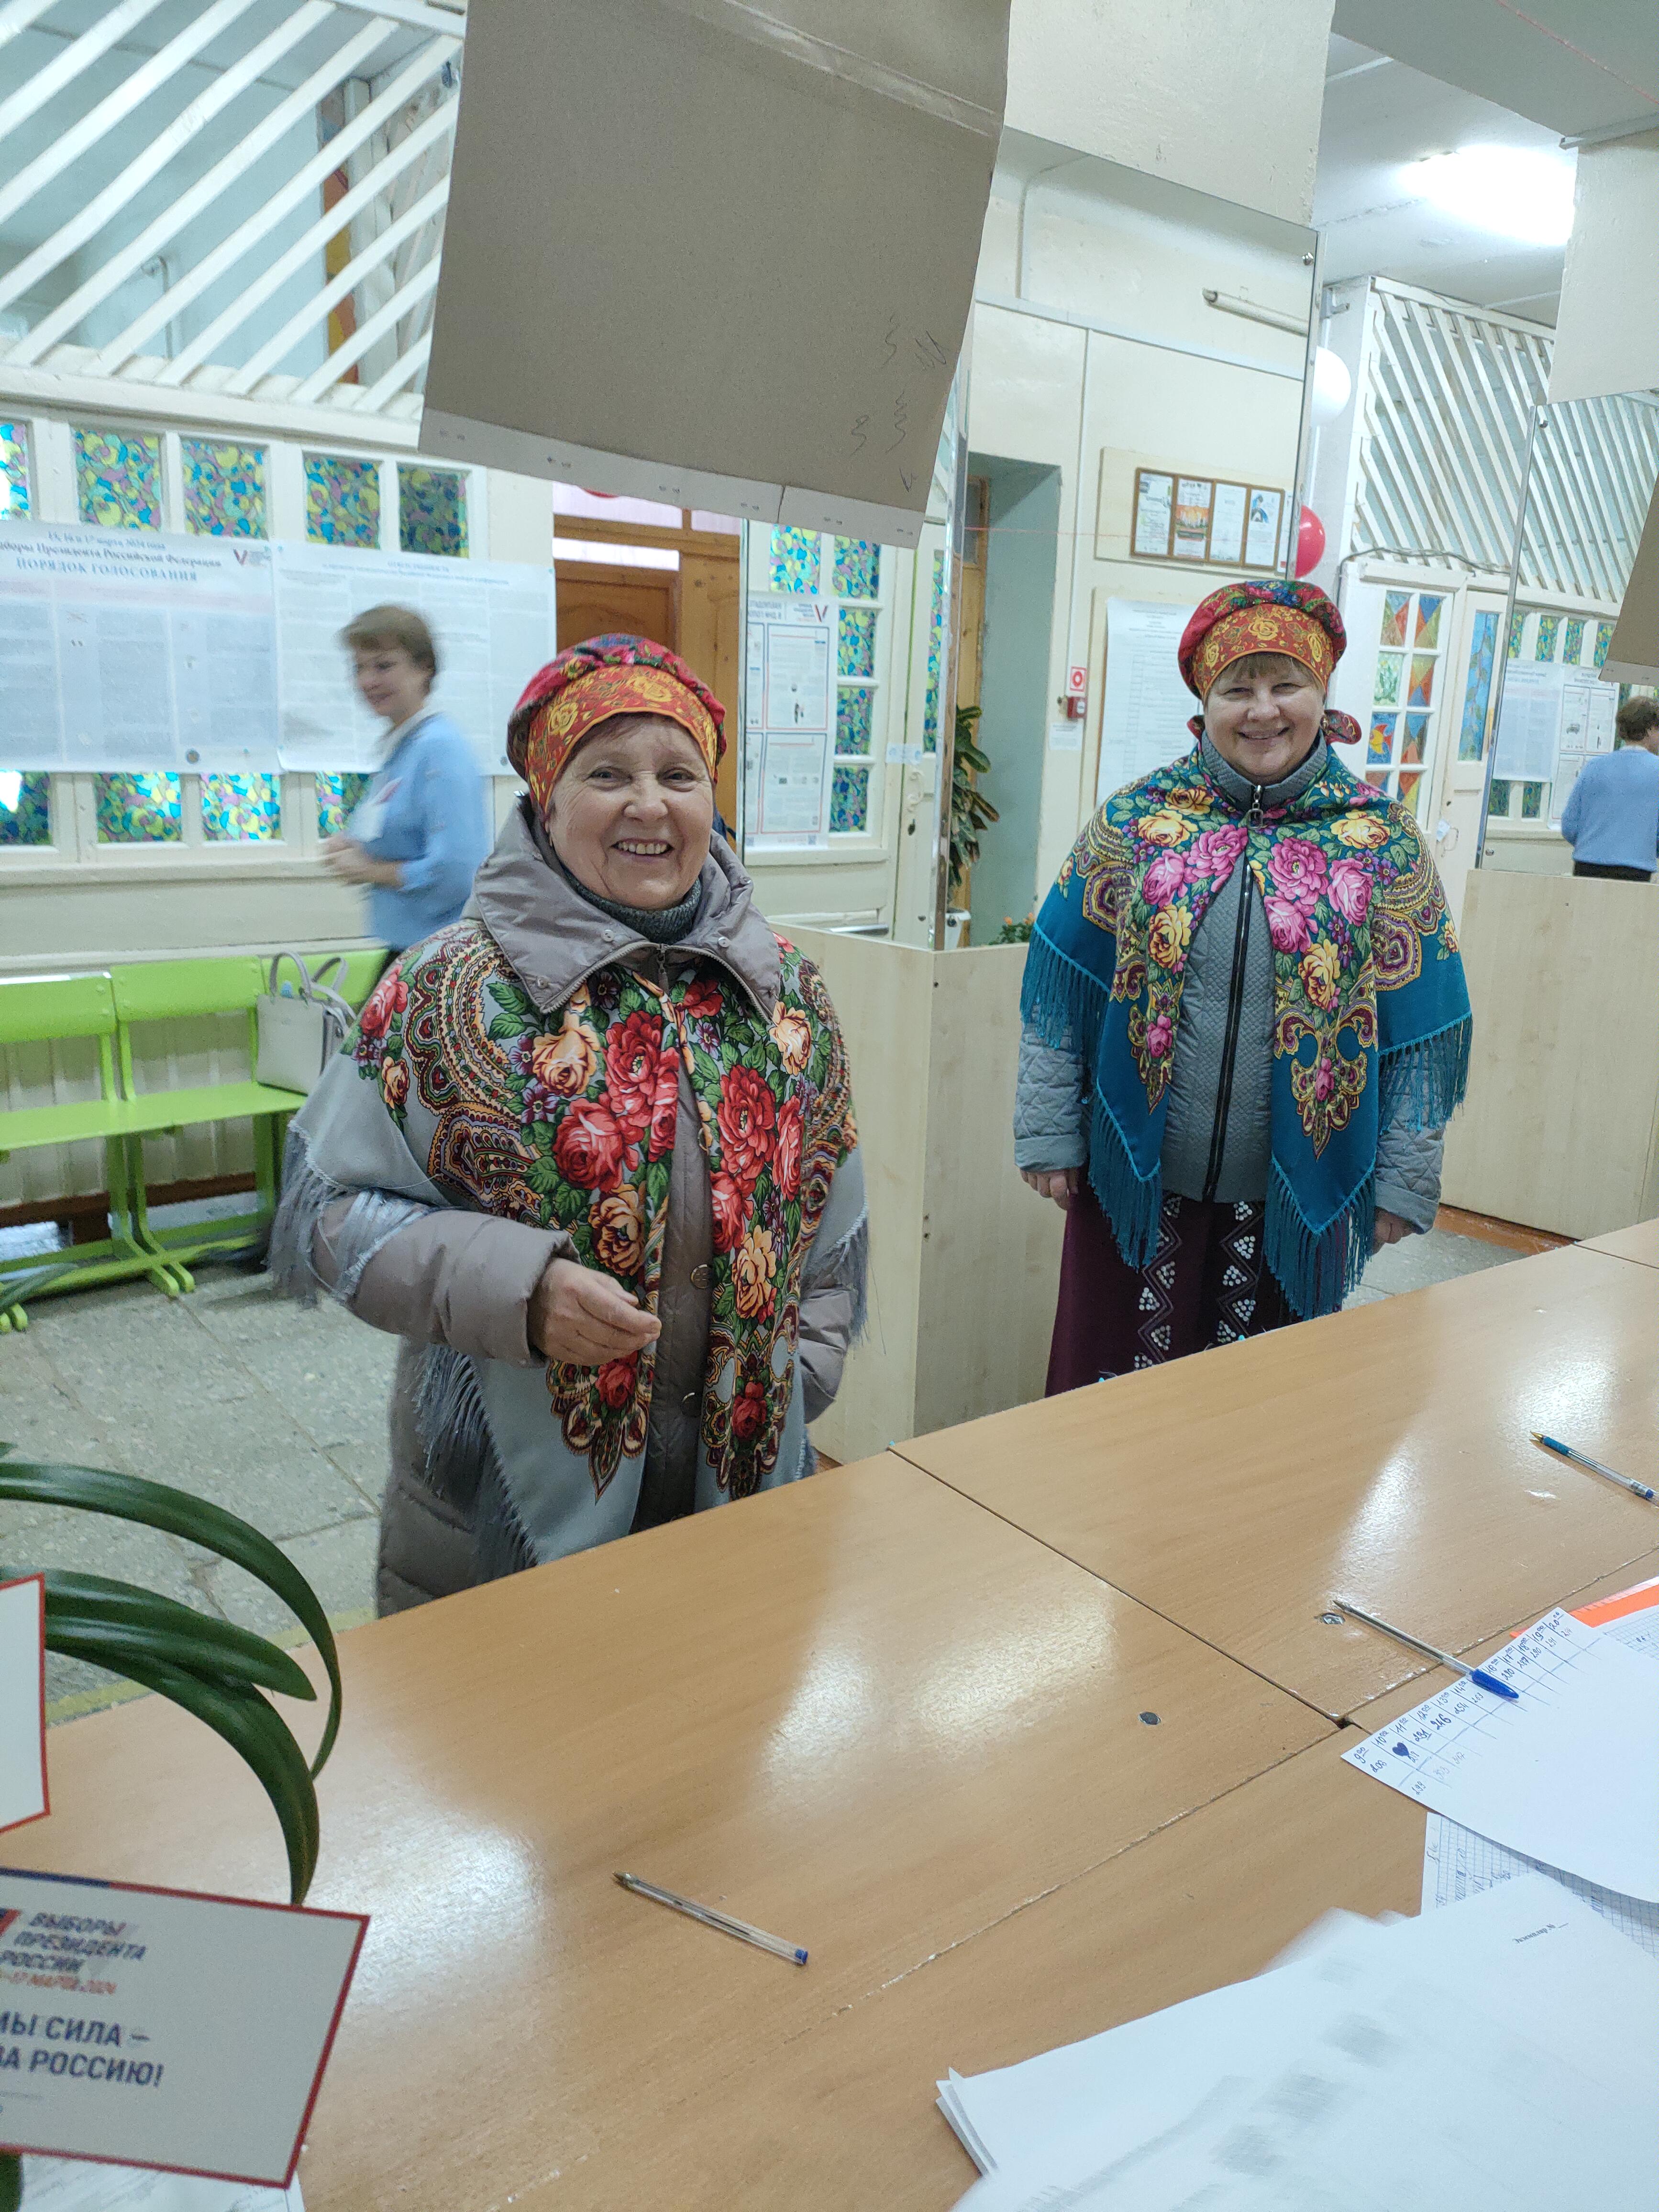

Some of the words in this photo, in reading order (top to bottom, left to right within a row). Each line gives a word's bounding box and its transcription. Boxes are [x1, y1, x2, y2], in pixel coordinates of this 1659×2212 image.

[17, 557, 87, 574] ПОРЯДОК
[91, 563, 197, 581] ГОЛОСОВАНИЯ
[1430, 1713, 1451, 1730] 246
[1454, 1702, 1469, 1714] 254
[29, 1912, 127, 1936] ВЫБОРЫ
[14, 1930, 146, 1960] ПРЕЗИДЕНТА
[0, 1950, 85, 1973] РОССИИ
[45, 2015, 121, 2048] СИЛА
[29, 2049, 165, 2089] РОССИЮ!
